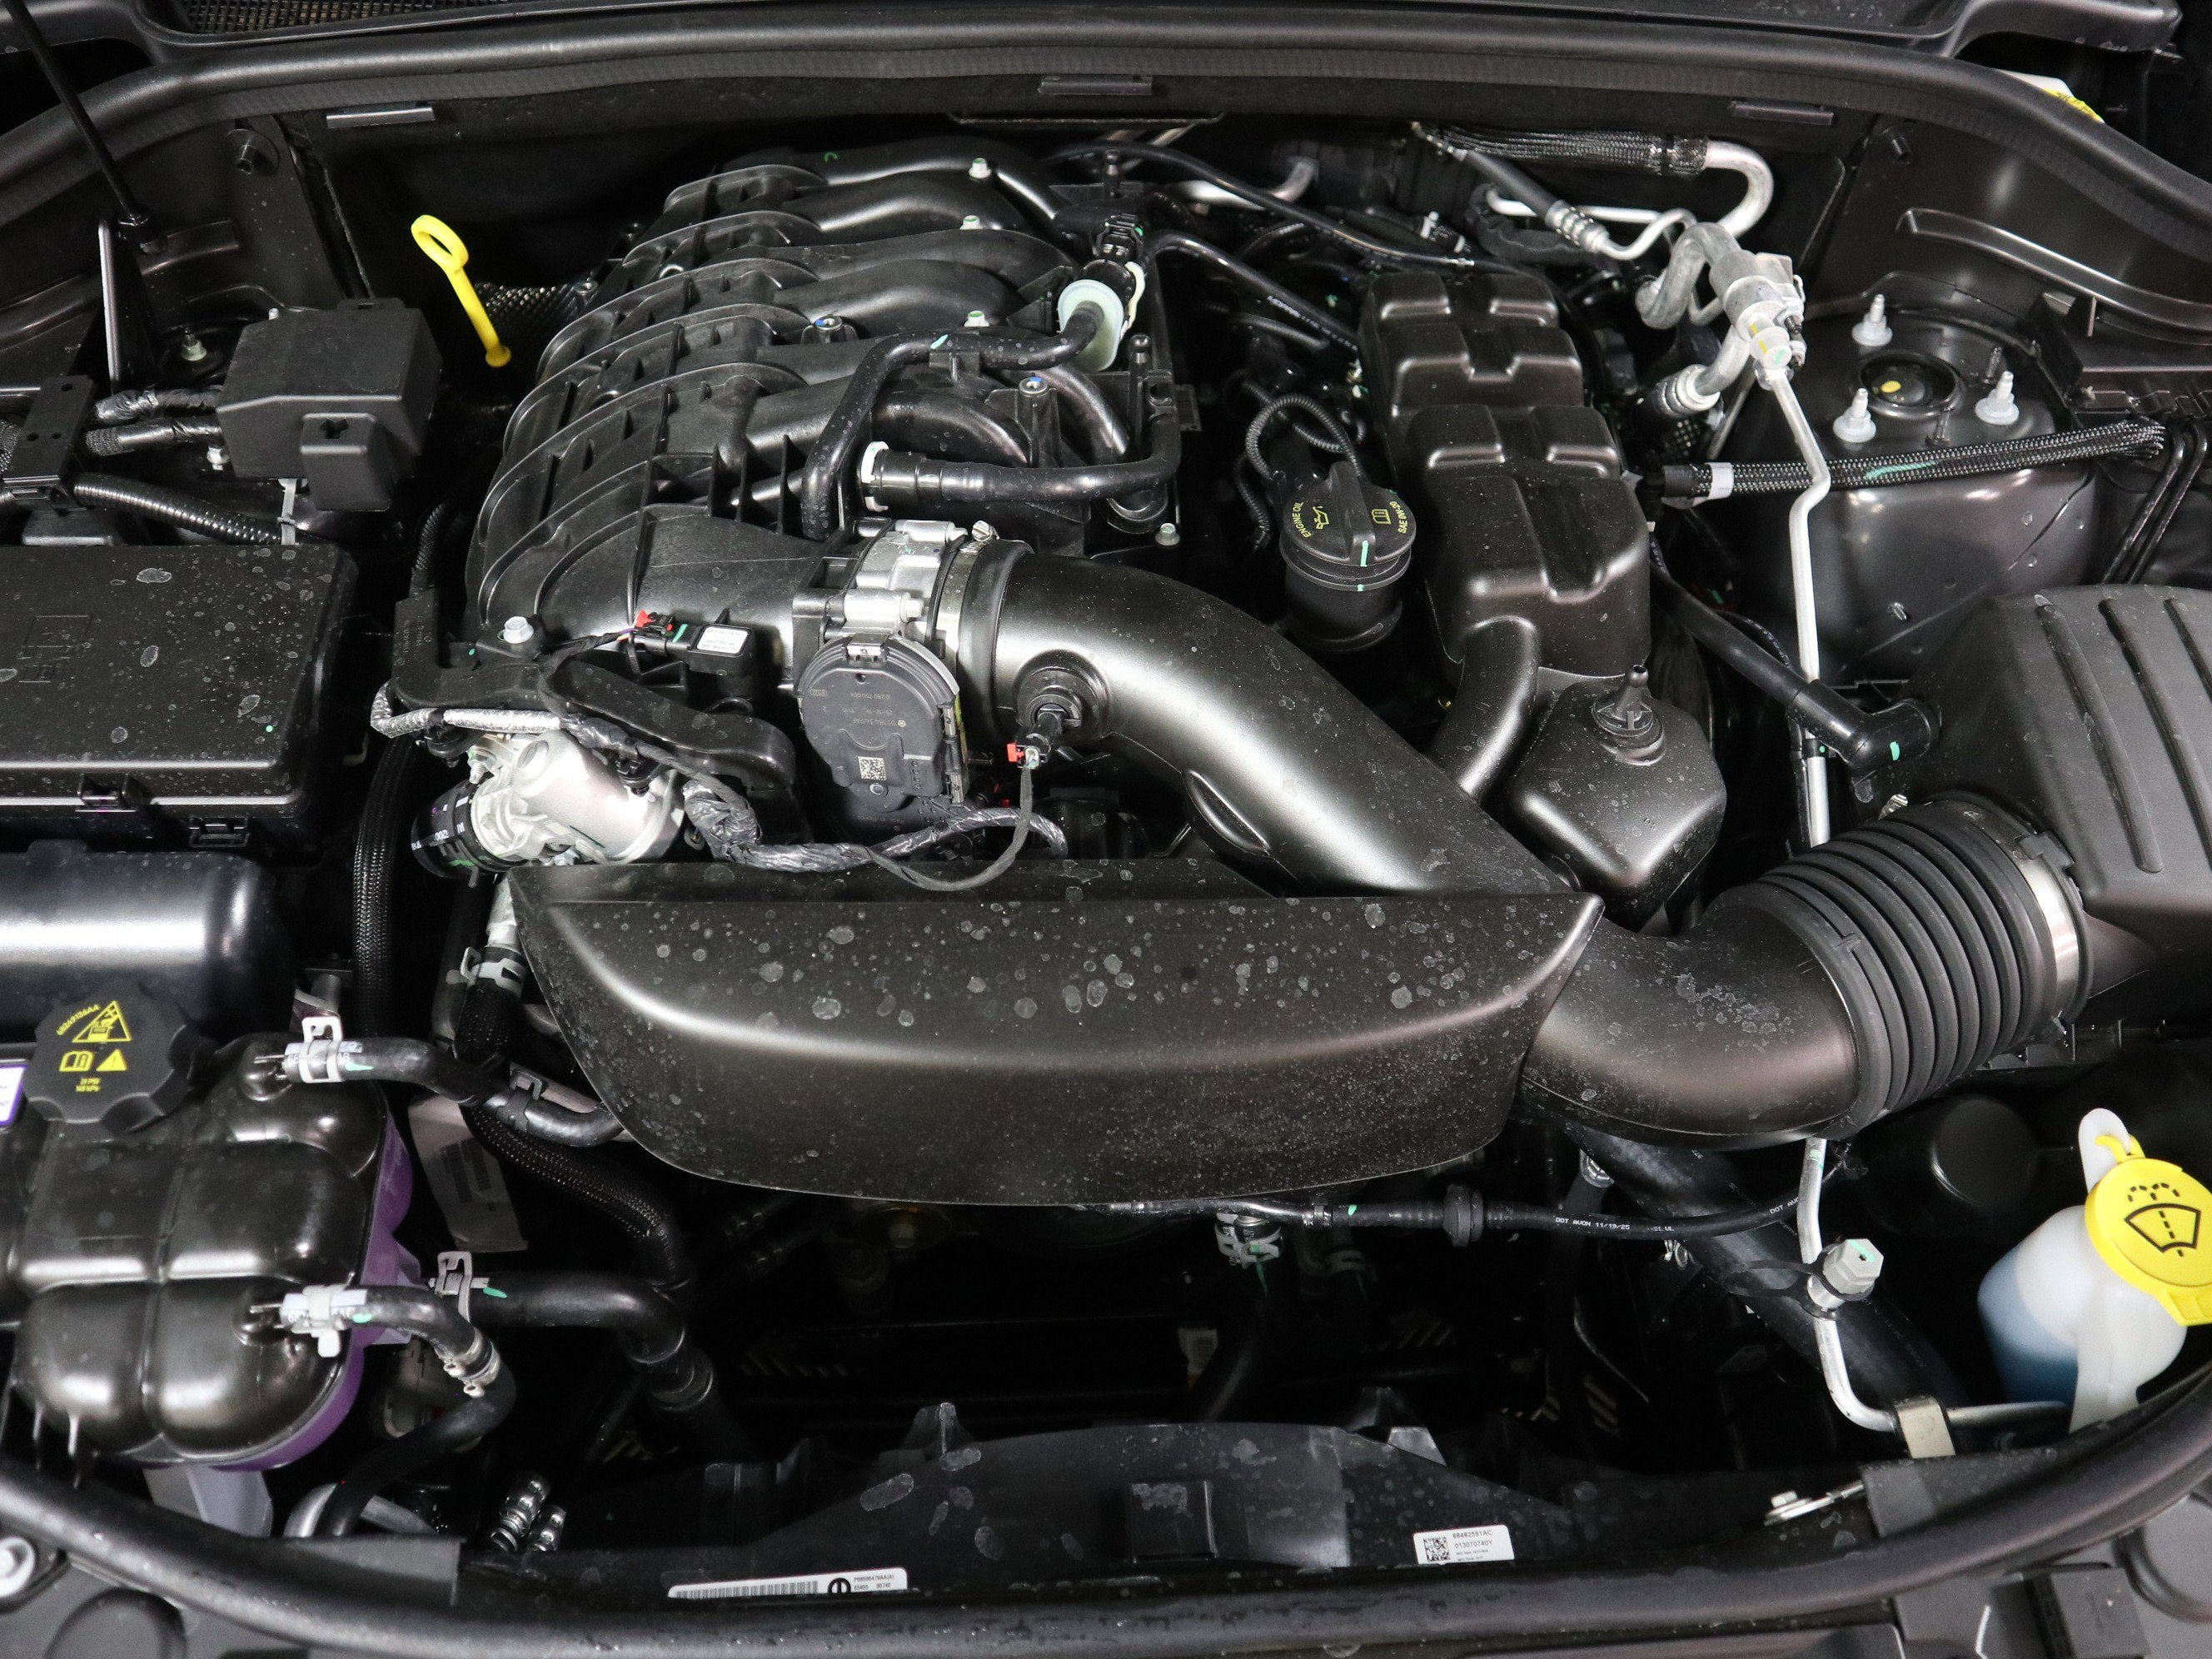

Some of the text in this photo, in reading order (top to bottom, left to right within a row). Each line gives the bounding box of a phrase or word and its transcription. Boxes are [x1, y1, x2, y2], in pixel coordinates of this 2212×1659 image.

[1292, 501, 1312, 538] ENGINE OIL
[1389, 501, 1408, 534] SAE 0W-20
[1769, 1204, 1784, 1214] DOT
[1595, 1222, 1631, 1230] 11/19/25
